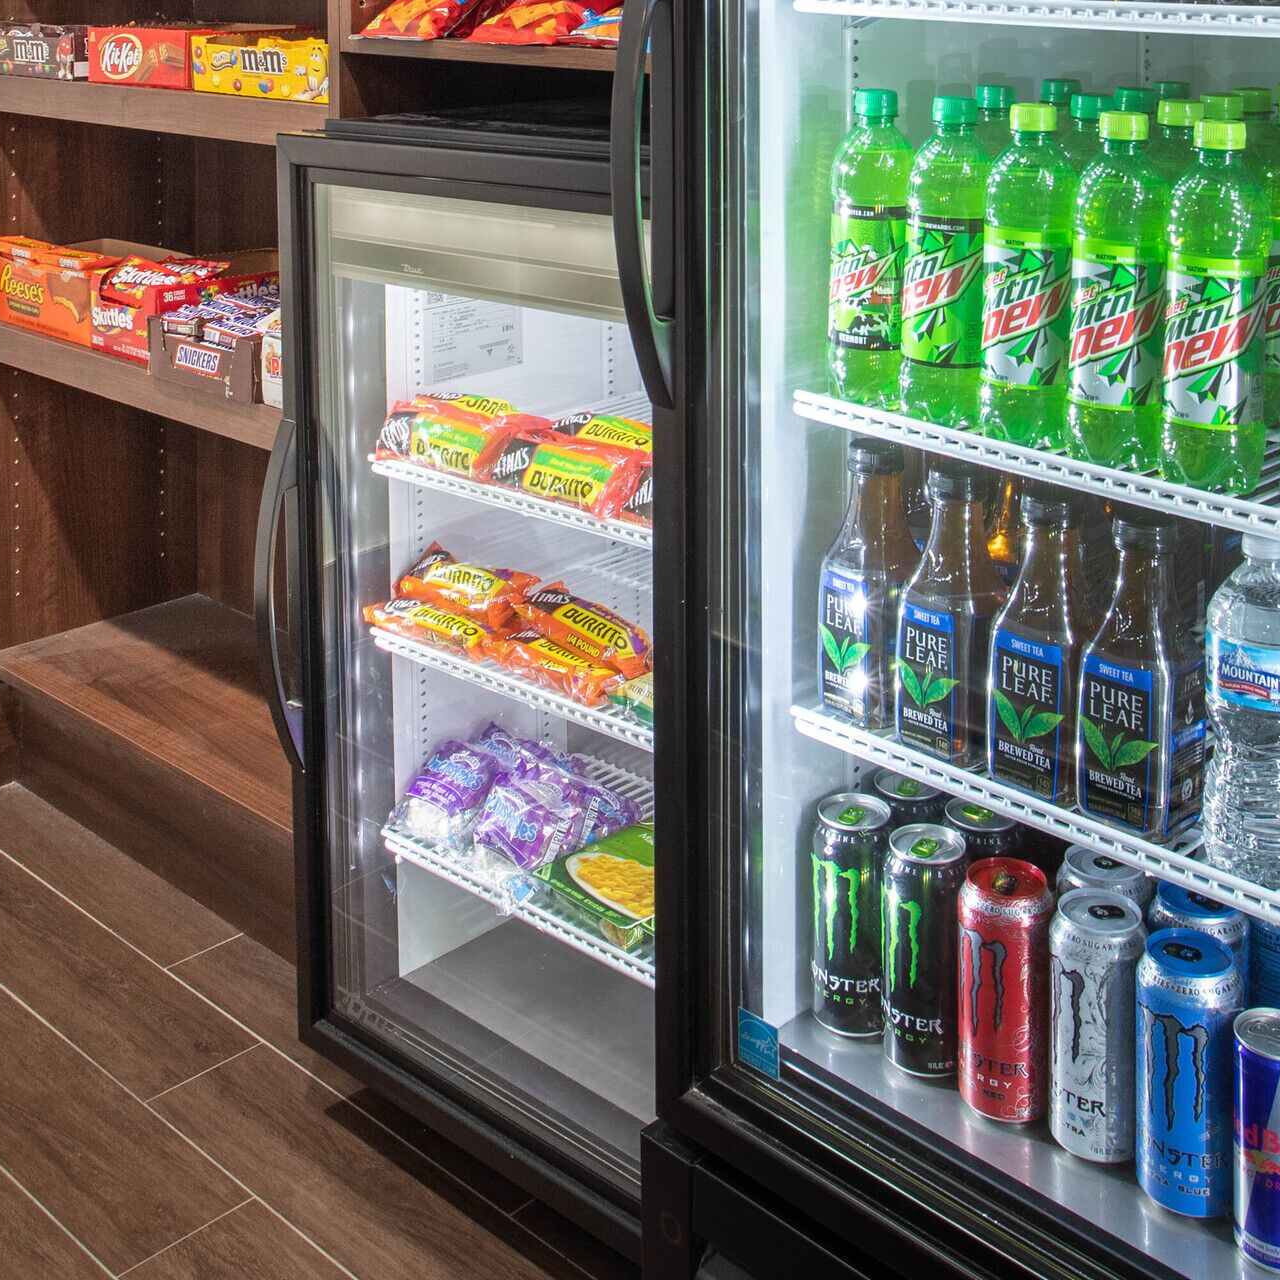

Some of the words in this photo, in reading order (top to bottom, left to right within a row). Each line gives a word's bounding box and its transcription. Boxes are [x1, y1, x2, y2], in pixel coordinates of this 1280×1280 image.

[163, 291, 174, 302] 36
[91, 306, 133, 330] Skittles
[1072, 290, 1134, 330] Mtn
[1167, 304, 1226, 344] Mtn
[838, 332, 868, 345] VERMONT
[177, 346, 219, 372] SNICKERS
[562, 606, 630, 650] BURRITO
[827, 610, 860, 635] LEAF
[914, 609, 930, 623] SWEET
[931, 614, 940, 626] TEA
[575, 637, 601, 658] POUND
[906, 626, 948, 654] PURE
[1011, 638, 1032, 654] SWEET
[1032, 645, 1044, 658] TEA
[905, 646, 948, 670] LEAF
[1002, 655, 1053, 688] PURE
[1099, 663, 1120, 679] SWEET
[1121, 669, 1134, 683] TEA
[1002, 672, 1054, 705] LEAF
[1090, 680, 1144, 715] PURE
[903, 706, 933, 728] BREWED
[934, 718, 948, 732] TEA
[929, 707, 942, 719] Real
[1089, 698, 1145, 733] LEAF
[998, 739, 1034, 763] BREWED
[1035, 755, 1051, 770] TEA
[1029, 743, 1045, 754] Real
[1089, 769, 1125, 793] BREWED
[1125, 786, 1142, 799] TEA
[1119, 771, 1136, 784] Real
[1001, 907, 1033, 917] SUGAR
[1082, 938, 1113, 952] SUGAR
[811, 959, 881, 993] ONSTER
[1175, 984, 1201, 997] ZERO
[882, 995, 944, 1035] NSTER
[973, 1052, 1030, 1079] STER
[1147, 1135, 1227, 1169] ONSTER
[1177, 1184, 1212, 1197] BLUE
